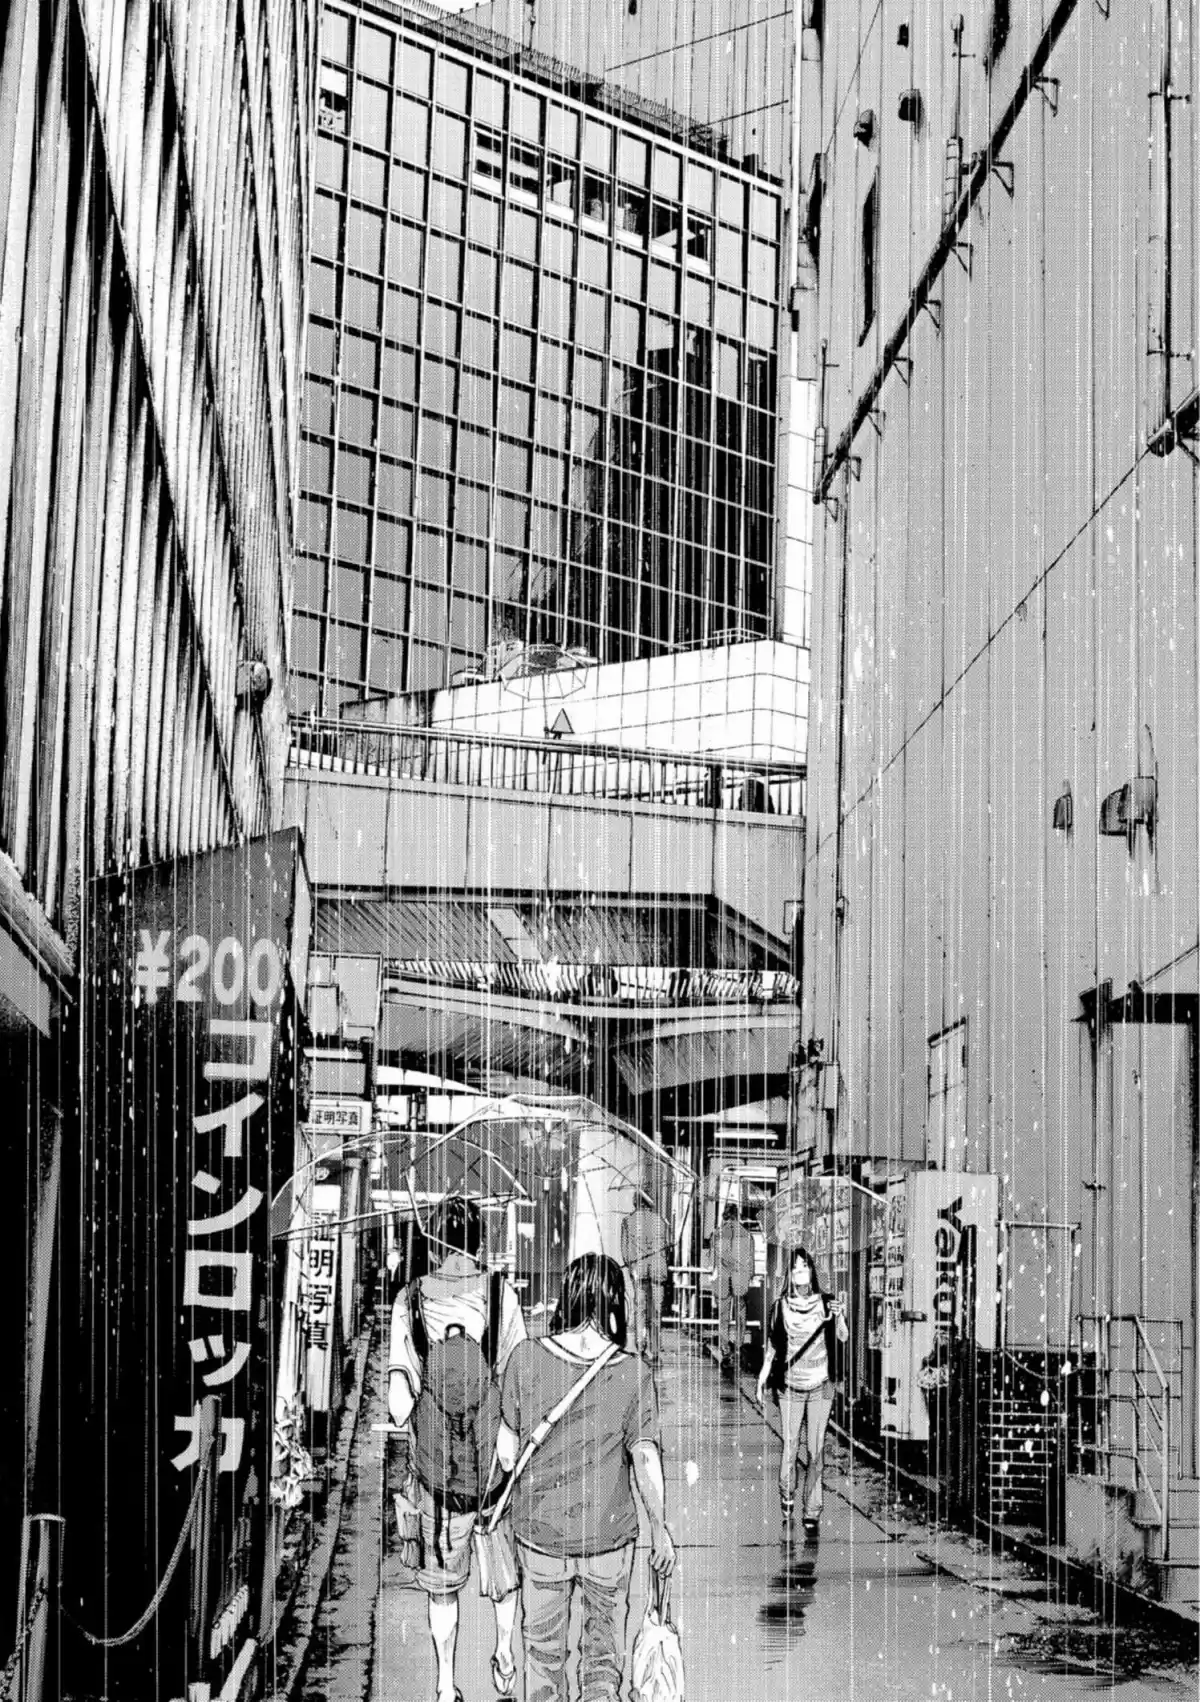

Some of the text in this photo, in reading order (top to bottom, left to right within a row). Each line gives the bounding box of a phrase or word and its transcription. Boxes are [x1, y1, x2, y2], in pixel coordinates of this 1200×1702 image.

[135, 928, 282, 1006] ¥200
[312, 1109, 359, 1126] 証明写真
[169, 1018, 274, 1473] コインロッカ
[307, 1212, 338, 1351] 証明写真
